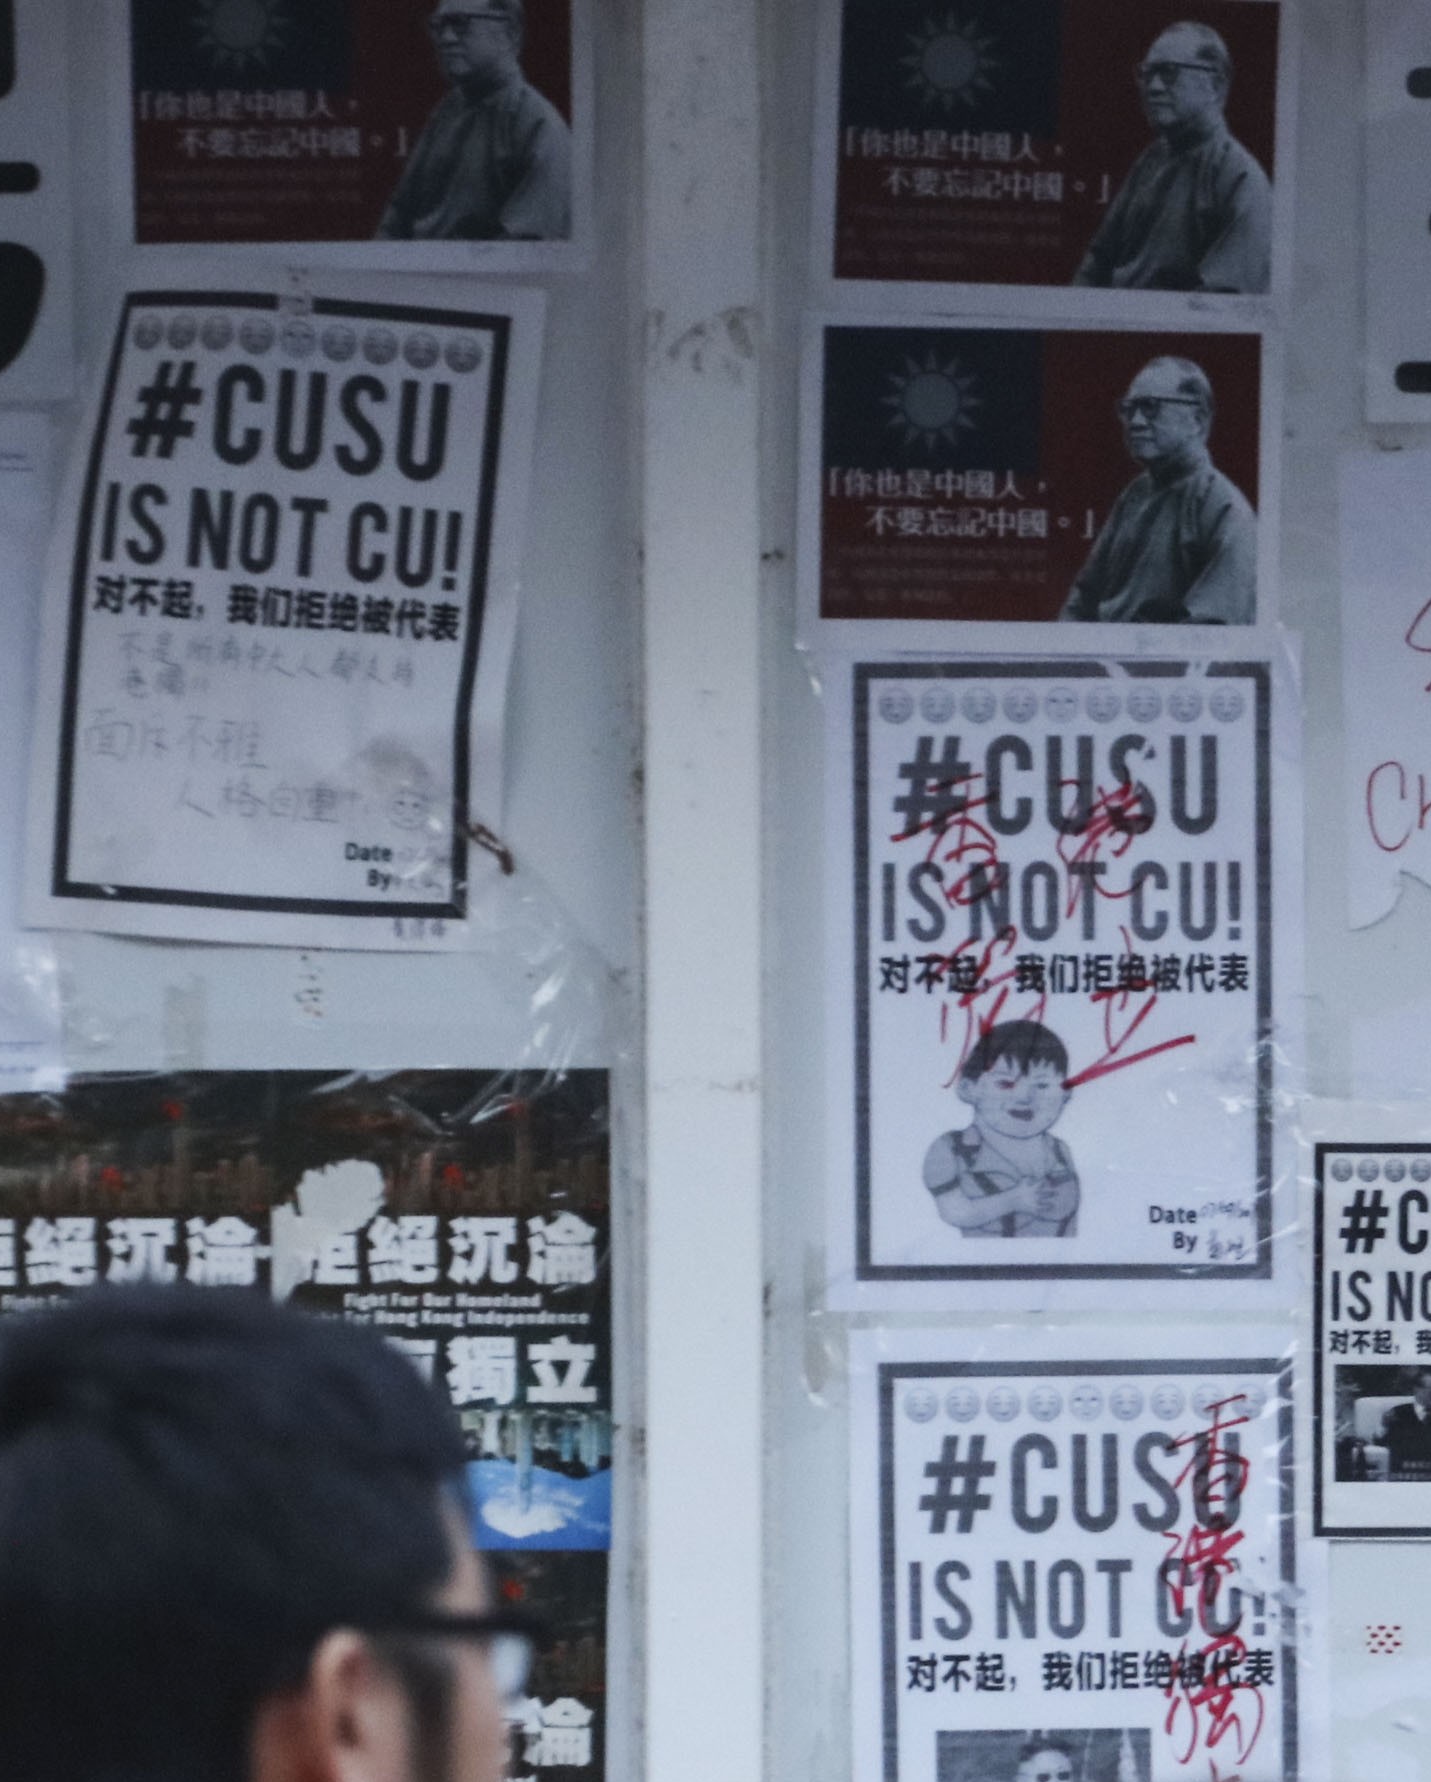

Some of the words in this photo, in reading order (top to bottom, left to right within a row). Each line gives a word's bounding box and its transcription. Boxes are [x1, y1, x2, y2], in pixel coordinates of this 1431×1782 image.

[126, 361, 452, 481] #CUSU
[100, 482, 167, 564] IS
[186, 487, 329, 576] NOT
[346, 501, 462, 590] CU!
[93, 576, 459, 642] 对不起，我们拒绝被代表
[893, 734, 1219, 835] #CUSU
[882, 861, 946, 942] IS
[969, 861, 1106, 942] NOT
[1130, 861, 1242, 942] CU!
[879, 954, 1250, 995] 对不起，我们拒绝被代表
[1150, 1204, 1197, 1225] Date
[1332, 1270, 1372, 1322] IS
[918, 1431, 1242, 1534] #CUSU
[908, 1560, 972, 1641] IS
[996, 1559, 1133, 1639] NOT
[906, 1649, 1276, 1693] 对不起，我们拒绝被代表
